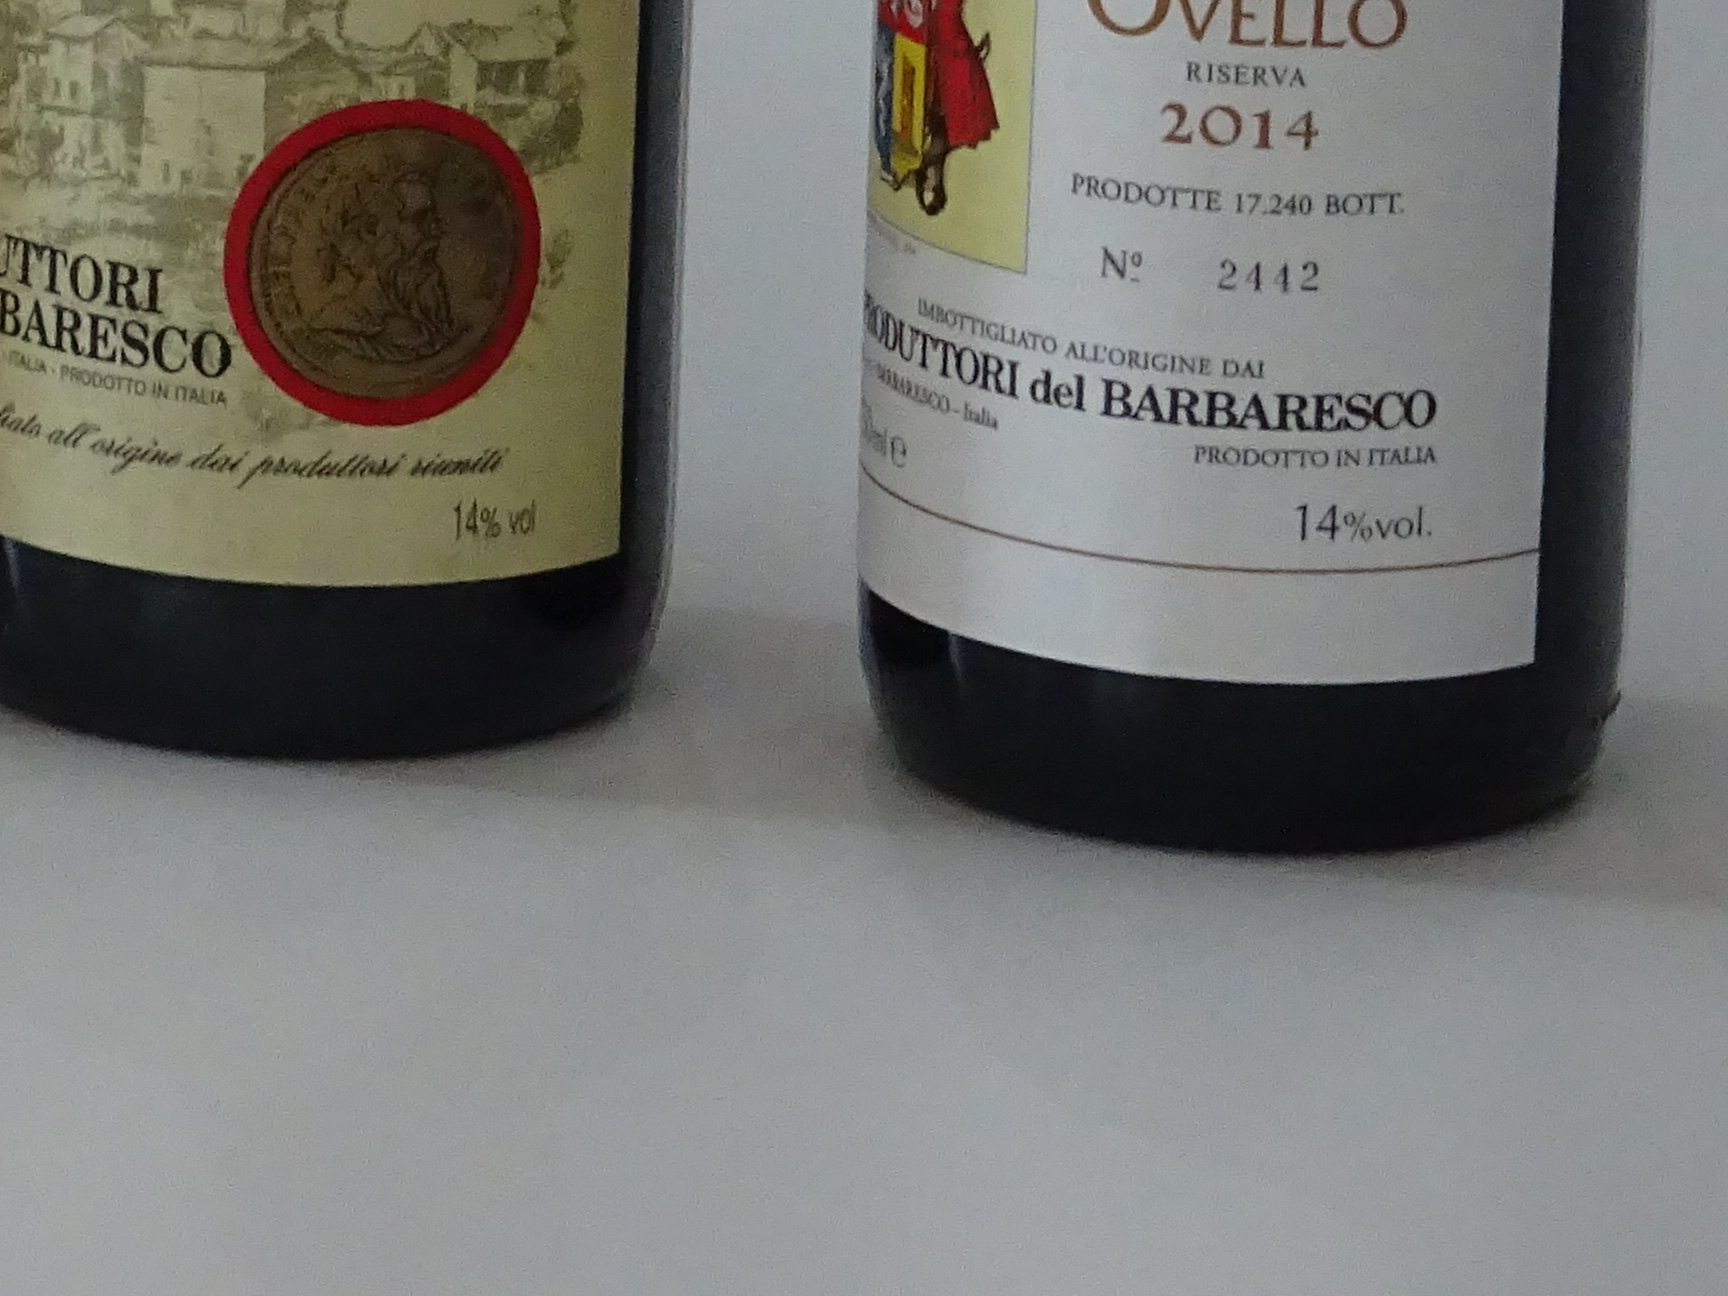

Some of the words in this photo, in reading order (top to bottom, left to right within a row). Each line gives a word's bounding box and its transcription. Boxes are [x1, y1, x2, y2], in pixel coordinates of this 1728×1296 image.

[1185, 60, 1309, 89] RISERVA
[1160, 101, 1320, 151] 2014
[1071, 171, 1225, 214] PRODOTTE
[1235, 191, 1314, 217] 17.240
[1324, 191, 1406, 218] BOTT.
[1217, 257, 1320, 296] 2442
[918, 296, 1058, 356] IMBOTTIGLIATO
[1064, 338, 1211, 378] ALL'ORIGINE
[1222, 358, 1266, 380] DAI
[59, 363, 147, 397] PRODOTTO
[151, 379, 171, 401] IN
[175, 385, 229, 408] ITALIA
[1028, 367, 1087, 413] del
[1099, 377, 1439, 433] BARBARESCO
[186, 442, 250, 474] dai
[1193, 444, 1329, 471] PRODOTTO
[1336, 447, 1361, 468] IN
[1367, 444, 1439, 468] ITALIA
[453, 498, 502, 541] 14%
